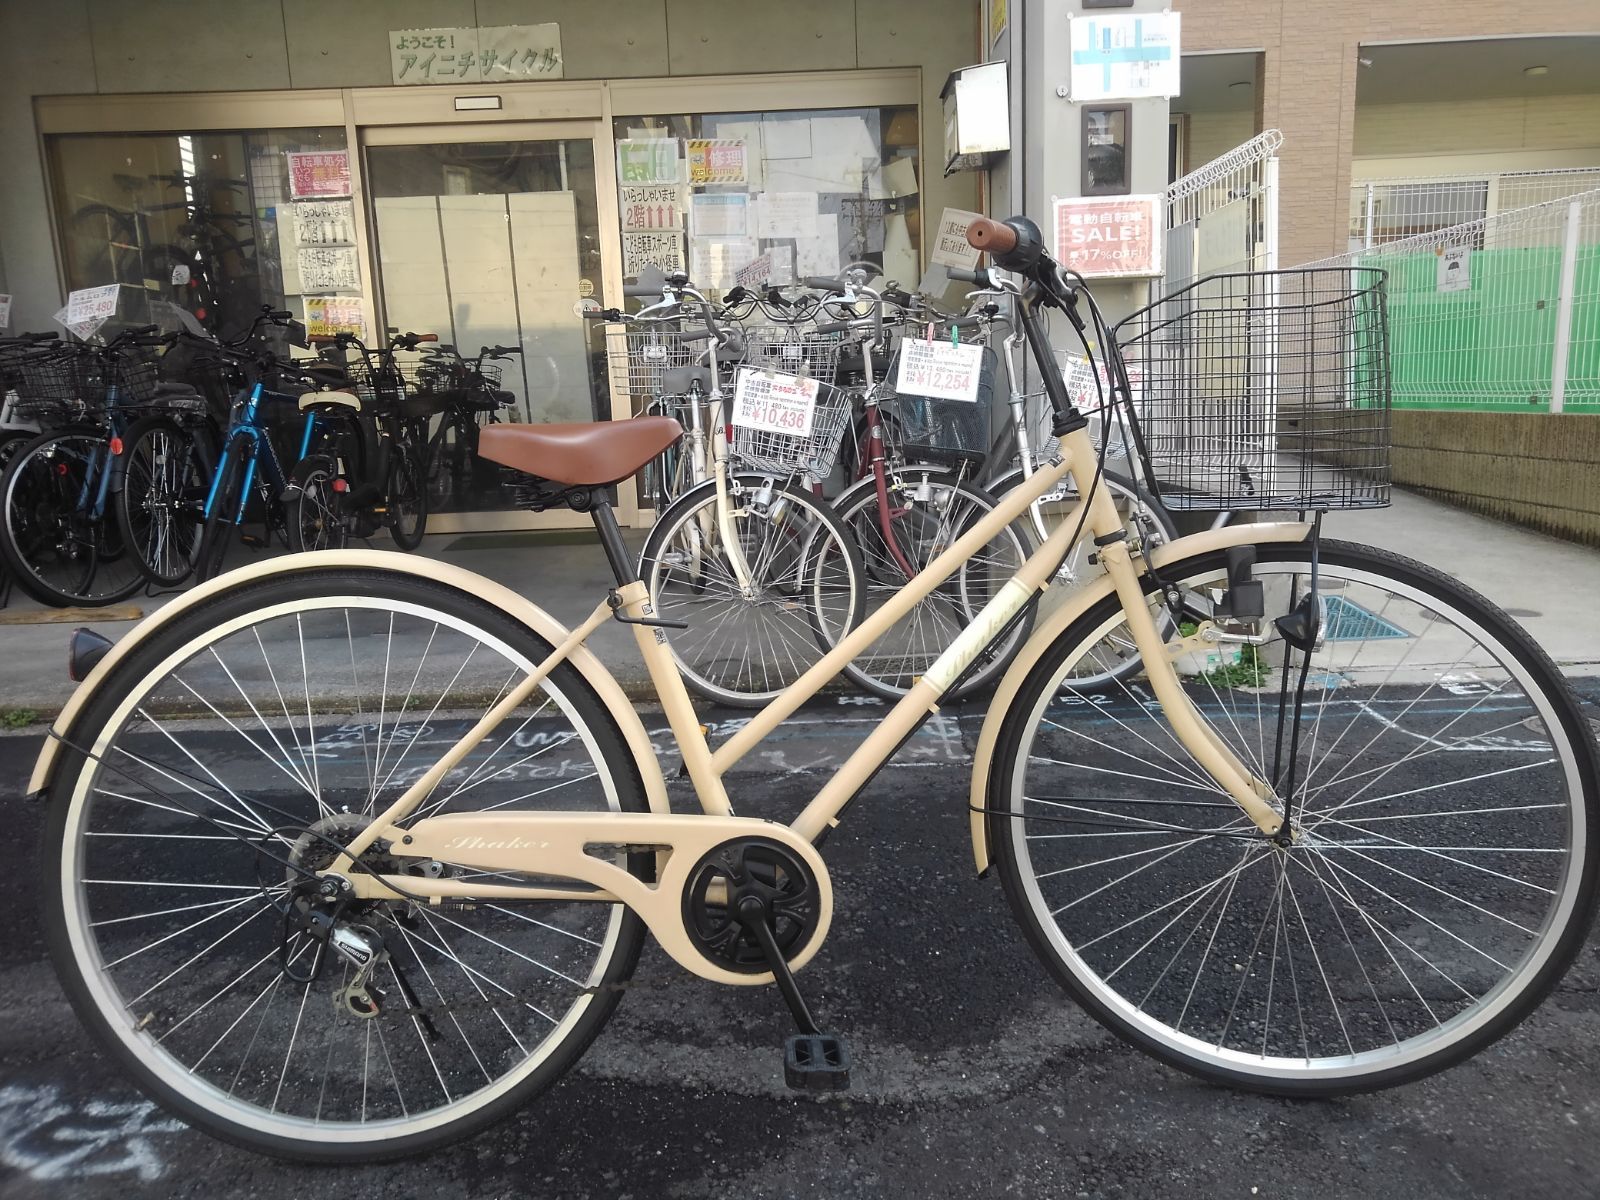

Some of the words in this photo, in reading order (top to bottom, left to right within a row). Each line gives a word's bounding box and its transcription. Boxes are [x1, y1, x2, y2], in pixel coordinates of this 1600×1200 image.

[399, 48, 558, 79] アイニチサイクル
[623, 188, 676, 202] いらっしゃいませ
[627, 205, 645, 228] 2階
[1069, 212, 1142, 225] 電動自転車
[1071, 225, 1140, 243] SALE!
[916, 371, 971, 391] ¥12,254
[752, 406, 805, 429] ¥10,436
